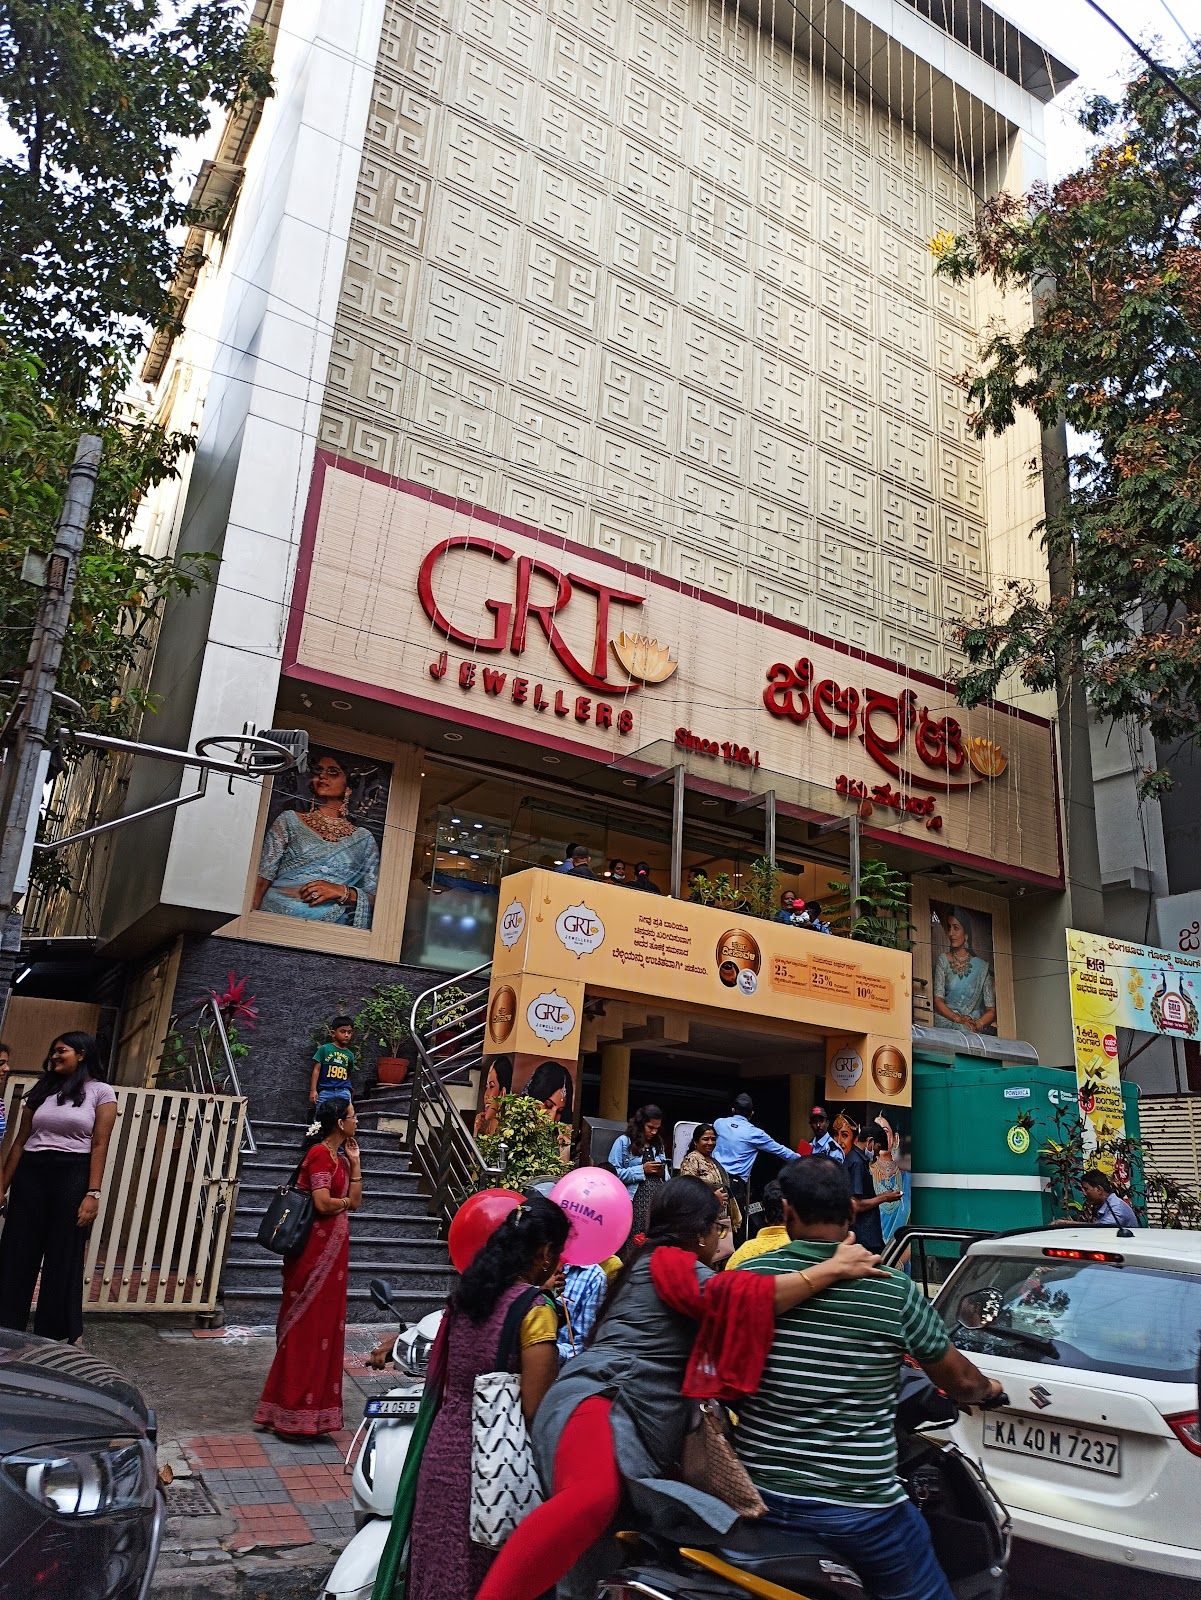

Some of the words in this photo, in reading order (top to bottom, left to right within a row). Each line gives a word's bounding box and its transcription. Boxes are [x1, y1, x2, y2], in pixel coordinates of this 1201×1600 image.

[417, 536, 646, 693] GRT
[429, 650, 633, 734] JEWELLERS
[504, 911, 521, 929] GRT
[564, 915, 596, 936] GRT
[774, 964, 788, 977] 25
[1088, 958, 1104, 972] 36
[812, 972, 833, 987] 25%
[856, 986, 875, 1000] 10%
[534, 1003, 566, 1024] GRT
[1076, 1026, 1080, 1036] 1
[836, 1056, 857, 1072] GRT
[326, 1065, 348, 1080] 1985
[560, 1200, 604, 1226] BHIMA
[378, 1402, 390, 1414] KA
[995, 1420, 1016, 1446] KA
[1023, 1426, 1044, 1452] 40
[1050, 1432, 1061, 1456] M
[1068, 1434, 1117, 1467] 7237
